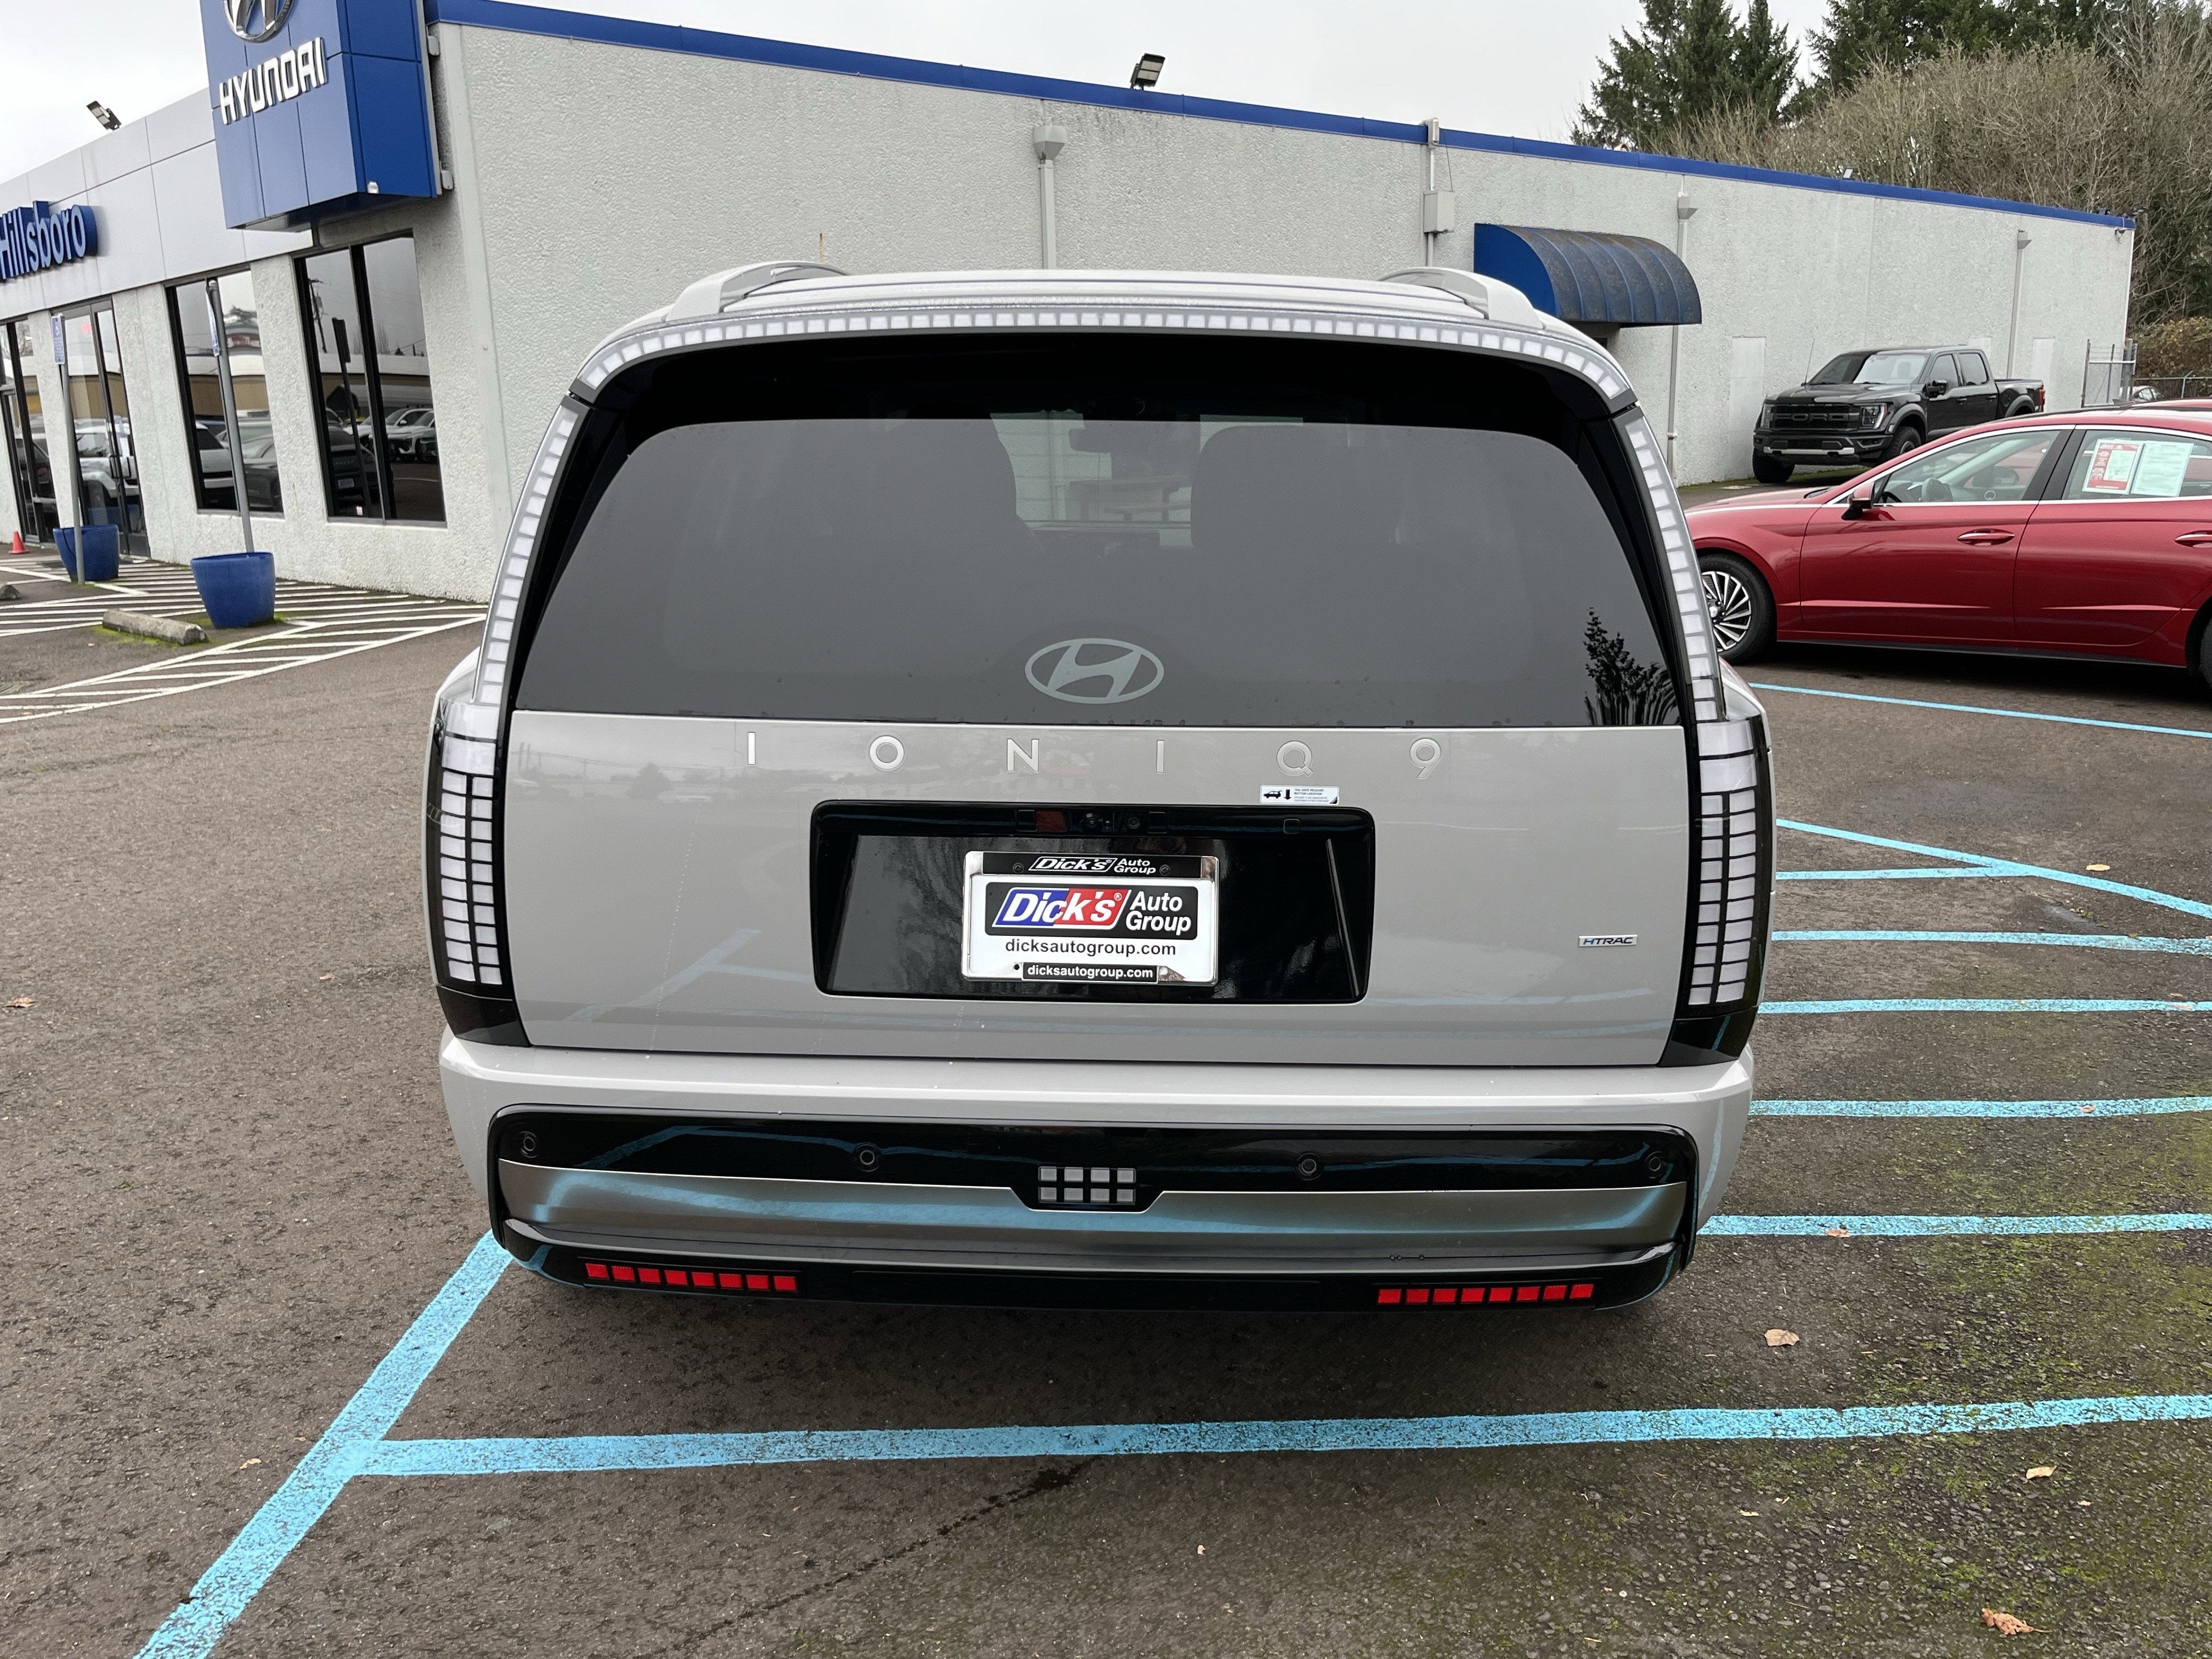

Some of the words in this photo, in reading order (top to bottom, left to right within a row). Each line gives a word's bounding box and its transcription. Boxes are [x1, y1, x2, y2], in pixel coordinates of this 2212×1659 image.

[219, 37, 327, 125] HYUNDAI
[0, 201, 87, 279] Hillsboro
[1773, 413, 1849, 421] FORD
[1035, 858, 1107, 870] Dick's
[1114, 865, 1156, 875] Group
[1117, 858, 1150, 866] Auto
[1002, 891, 1115, 923] Dick's
[1130, 891, 1183, 912] Auto
[1126, 910, 1192, 935] Group
[1005, 939, 1176, 957] dicksautogroup.com
[1583, 936, 1634, 945] HTRAC
[1027, 964, 1153, 980] dicksautogroup.com
